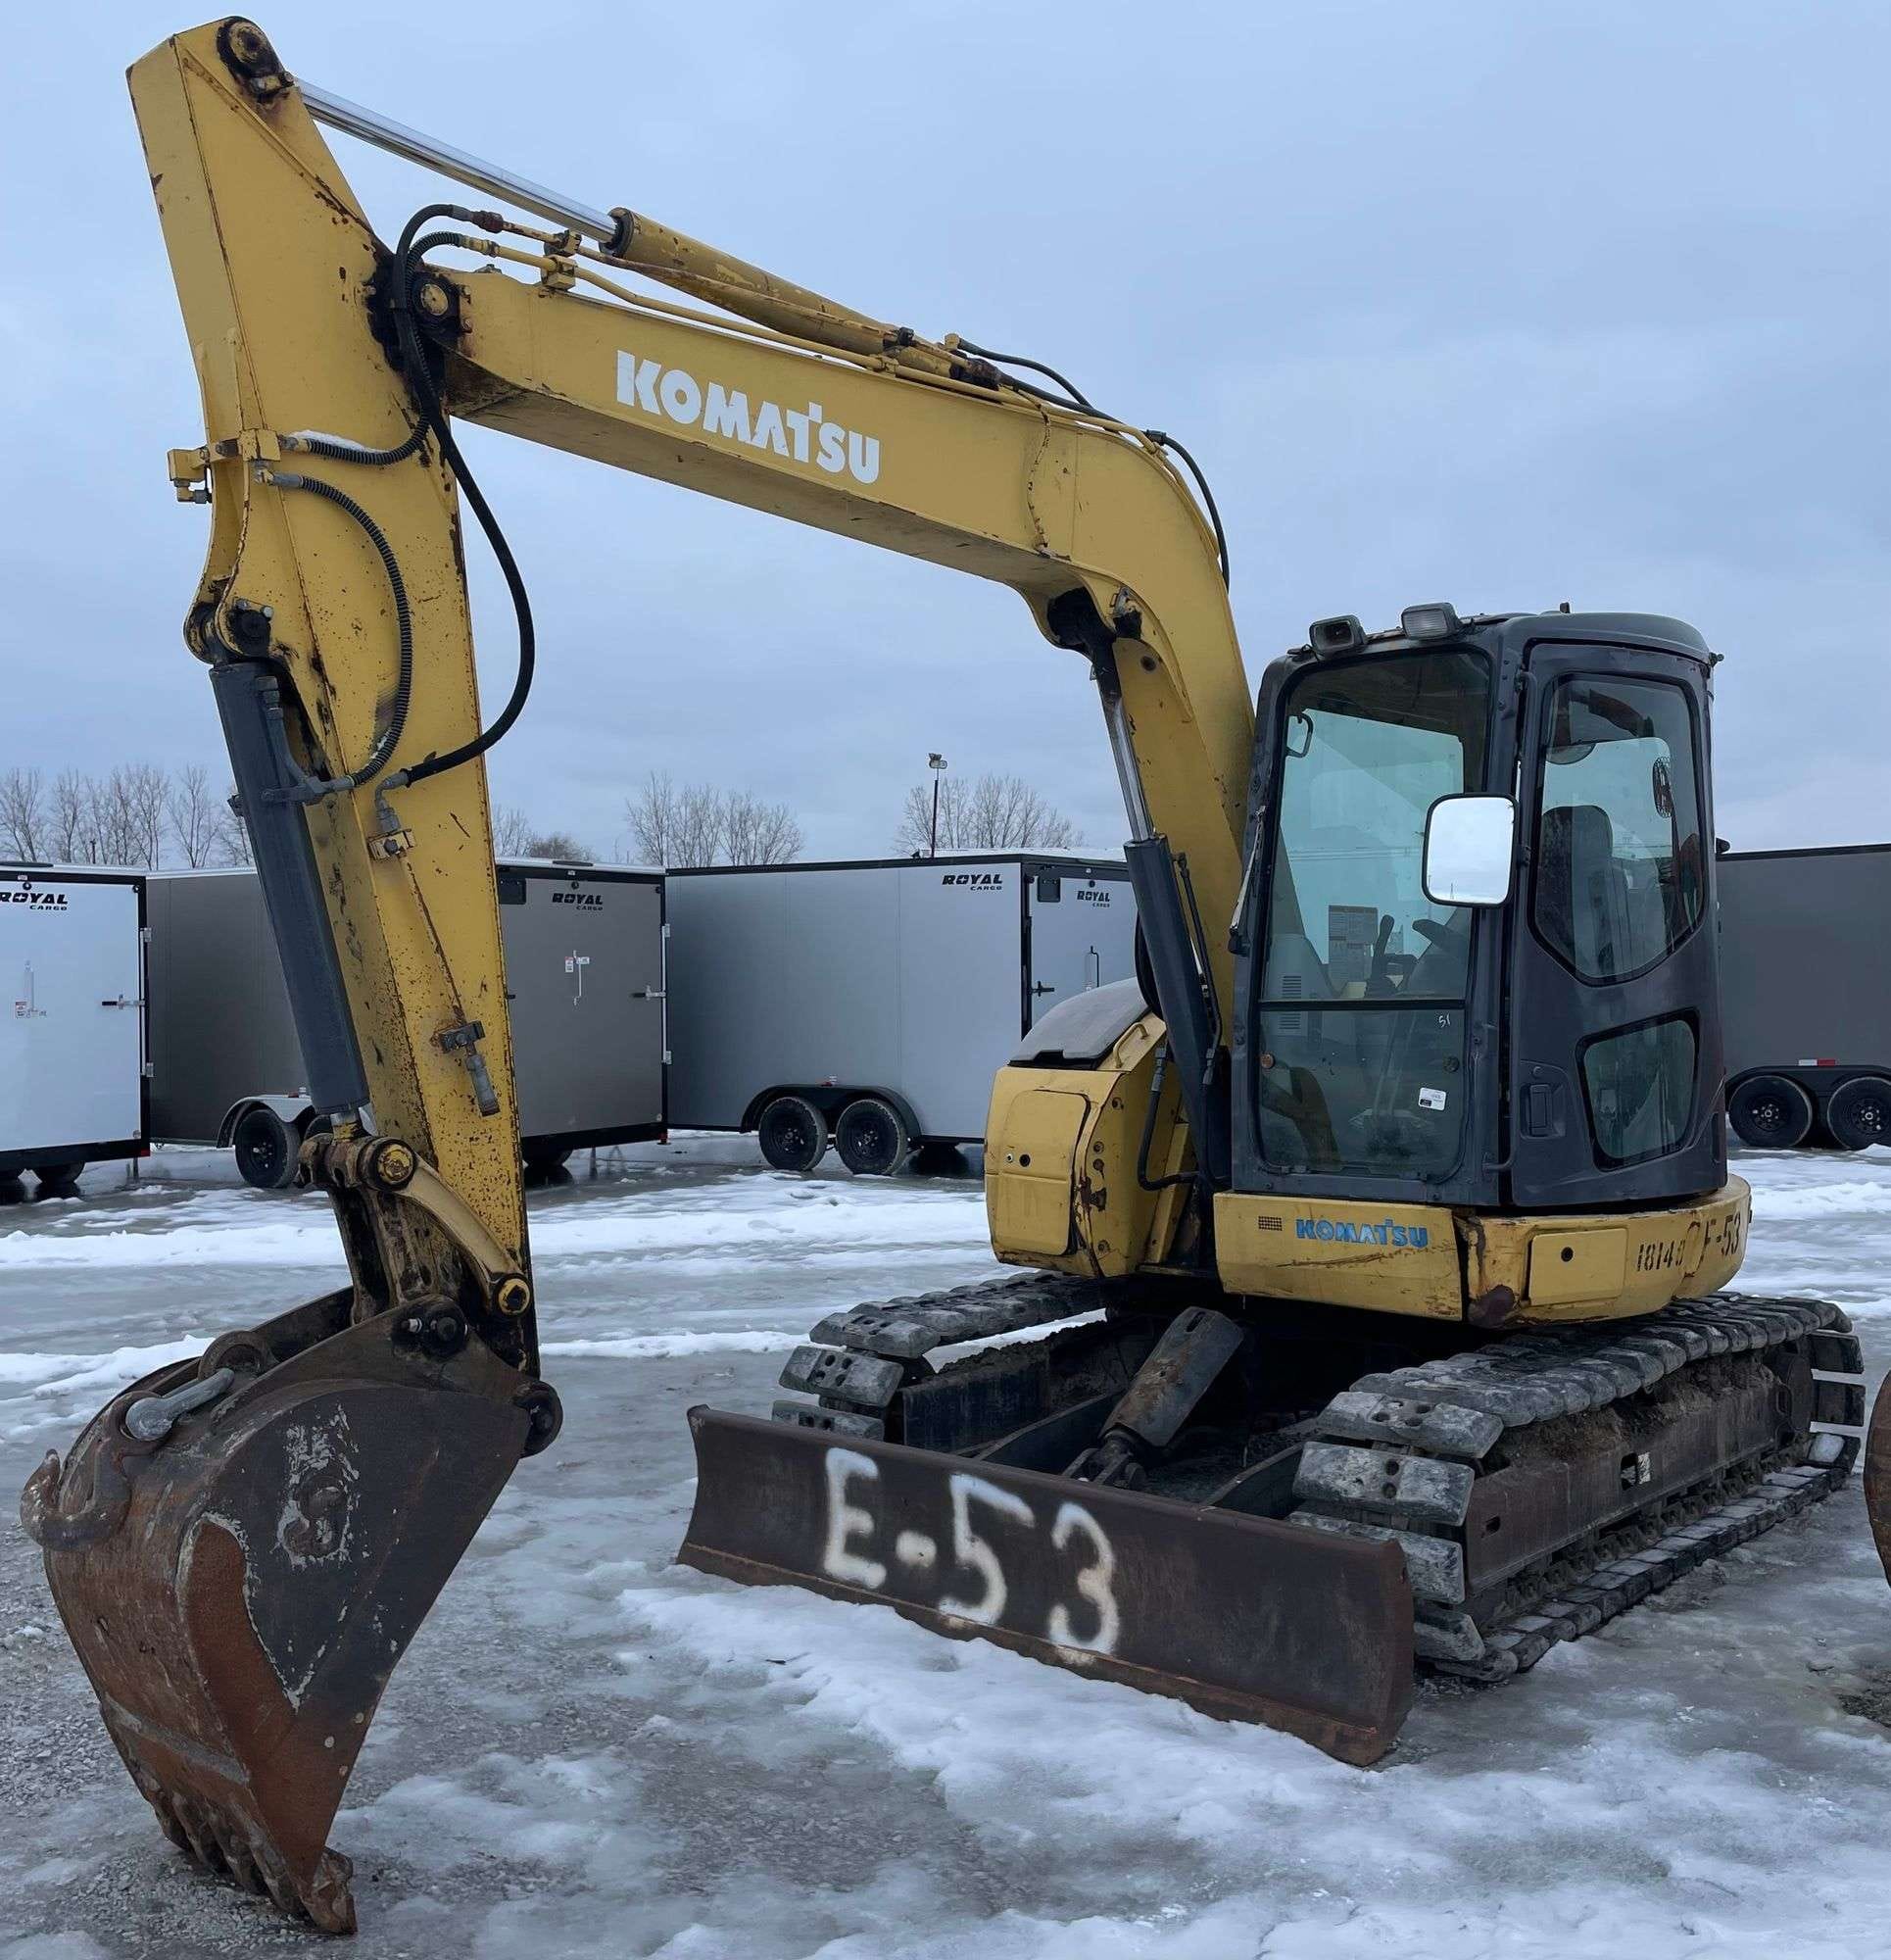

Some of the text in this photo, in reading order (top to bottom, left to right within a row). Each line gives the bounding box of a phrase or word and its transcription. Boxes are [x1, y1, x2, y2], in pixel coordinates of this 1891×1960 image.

[616, 350, 880, 484] KOMATSU
[942, 874, 1003, 885] ROYAL
[552, 893, 603, 905] ROYAL
[1077, 890, 1110, 902] ROYAL
[1295, 1218, 1429, 1248] KOMATSU
[824, 1446, 1120, 1656] E-53
